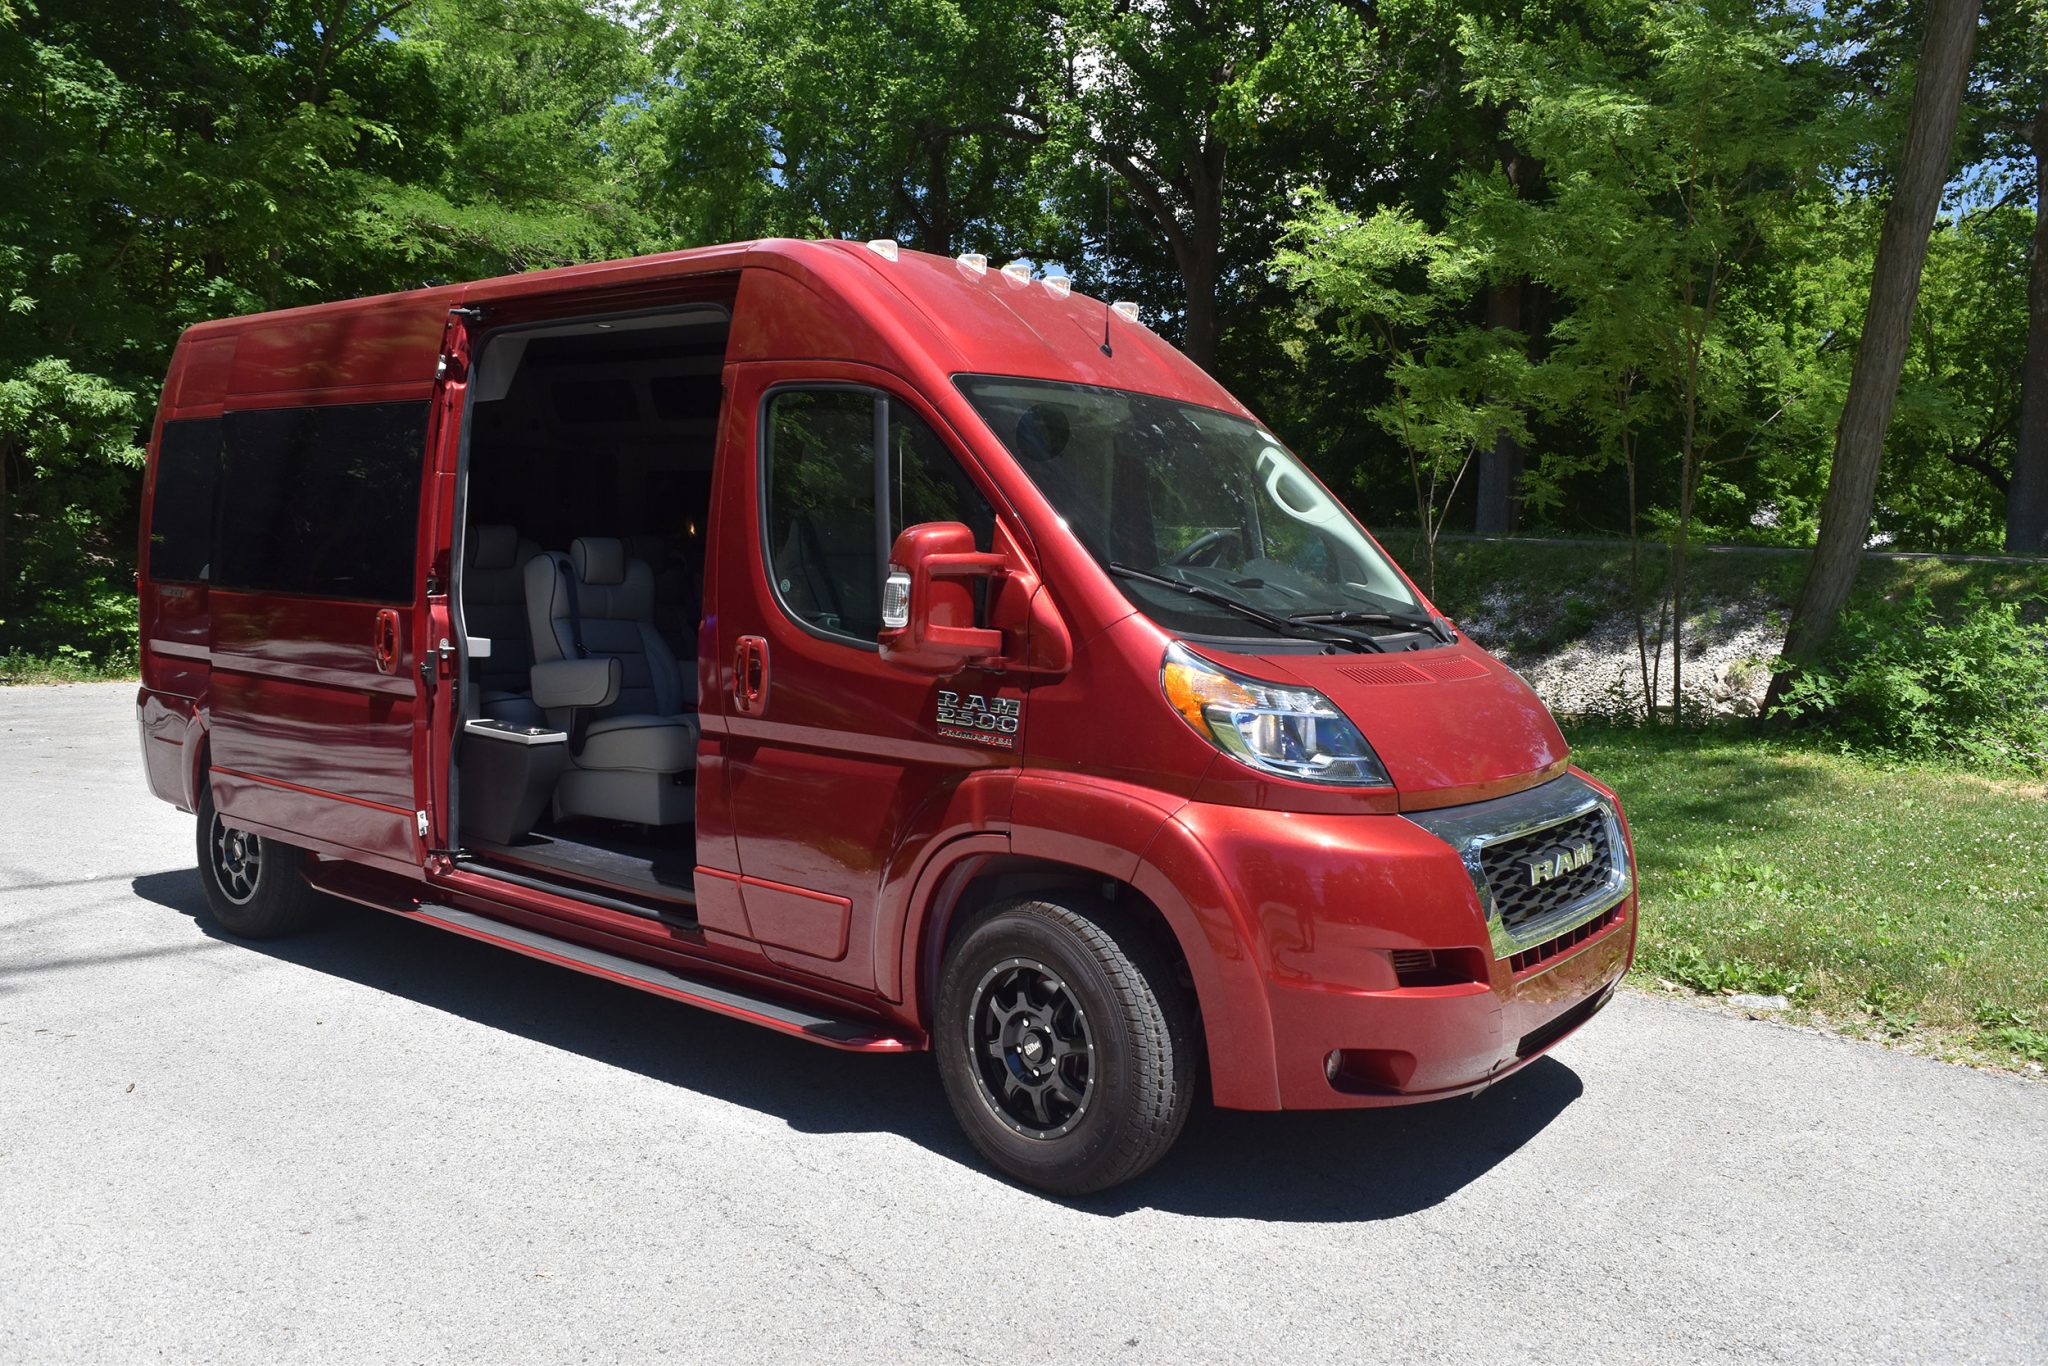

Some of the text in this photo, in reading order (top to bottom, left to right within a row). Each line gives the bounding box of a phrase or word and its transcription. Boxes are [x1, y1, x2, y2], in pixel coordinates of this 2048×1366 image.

[937, 690, 1020, 716] RAM
[936, 706, 1019, 733] 2500
[1529, 840, 1594, 887] RAM
